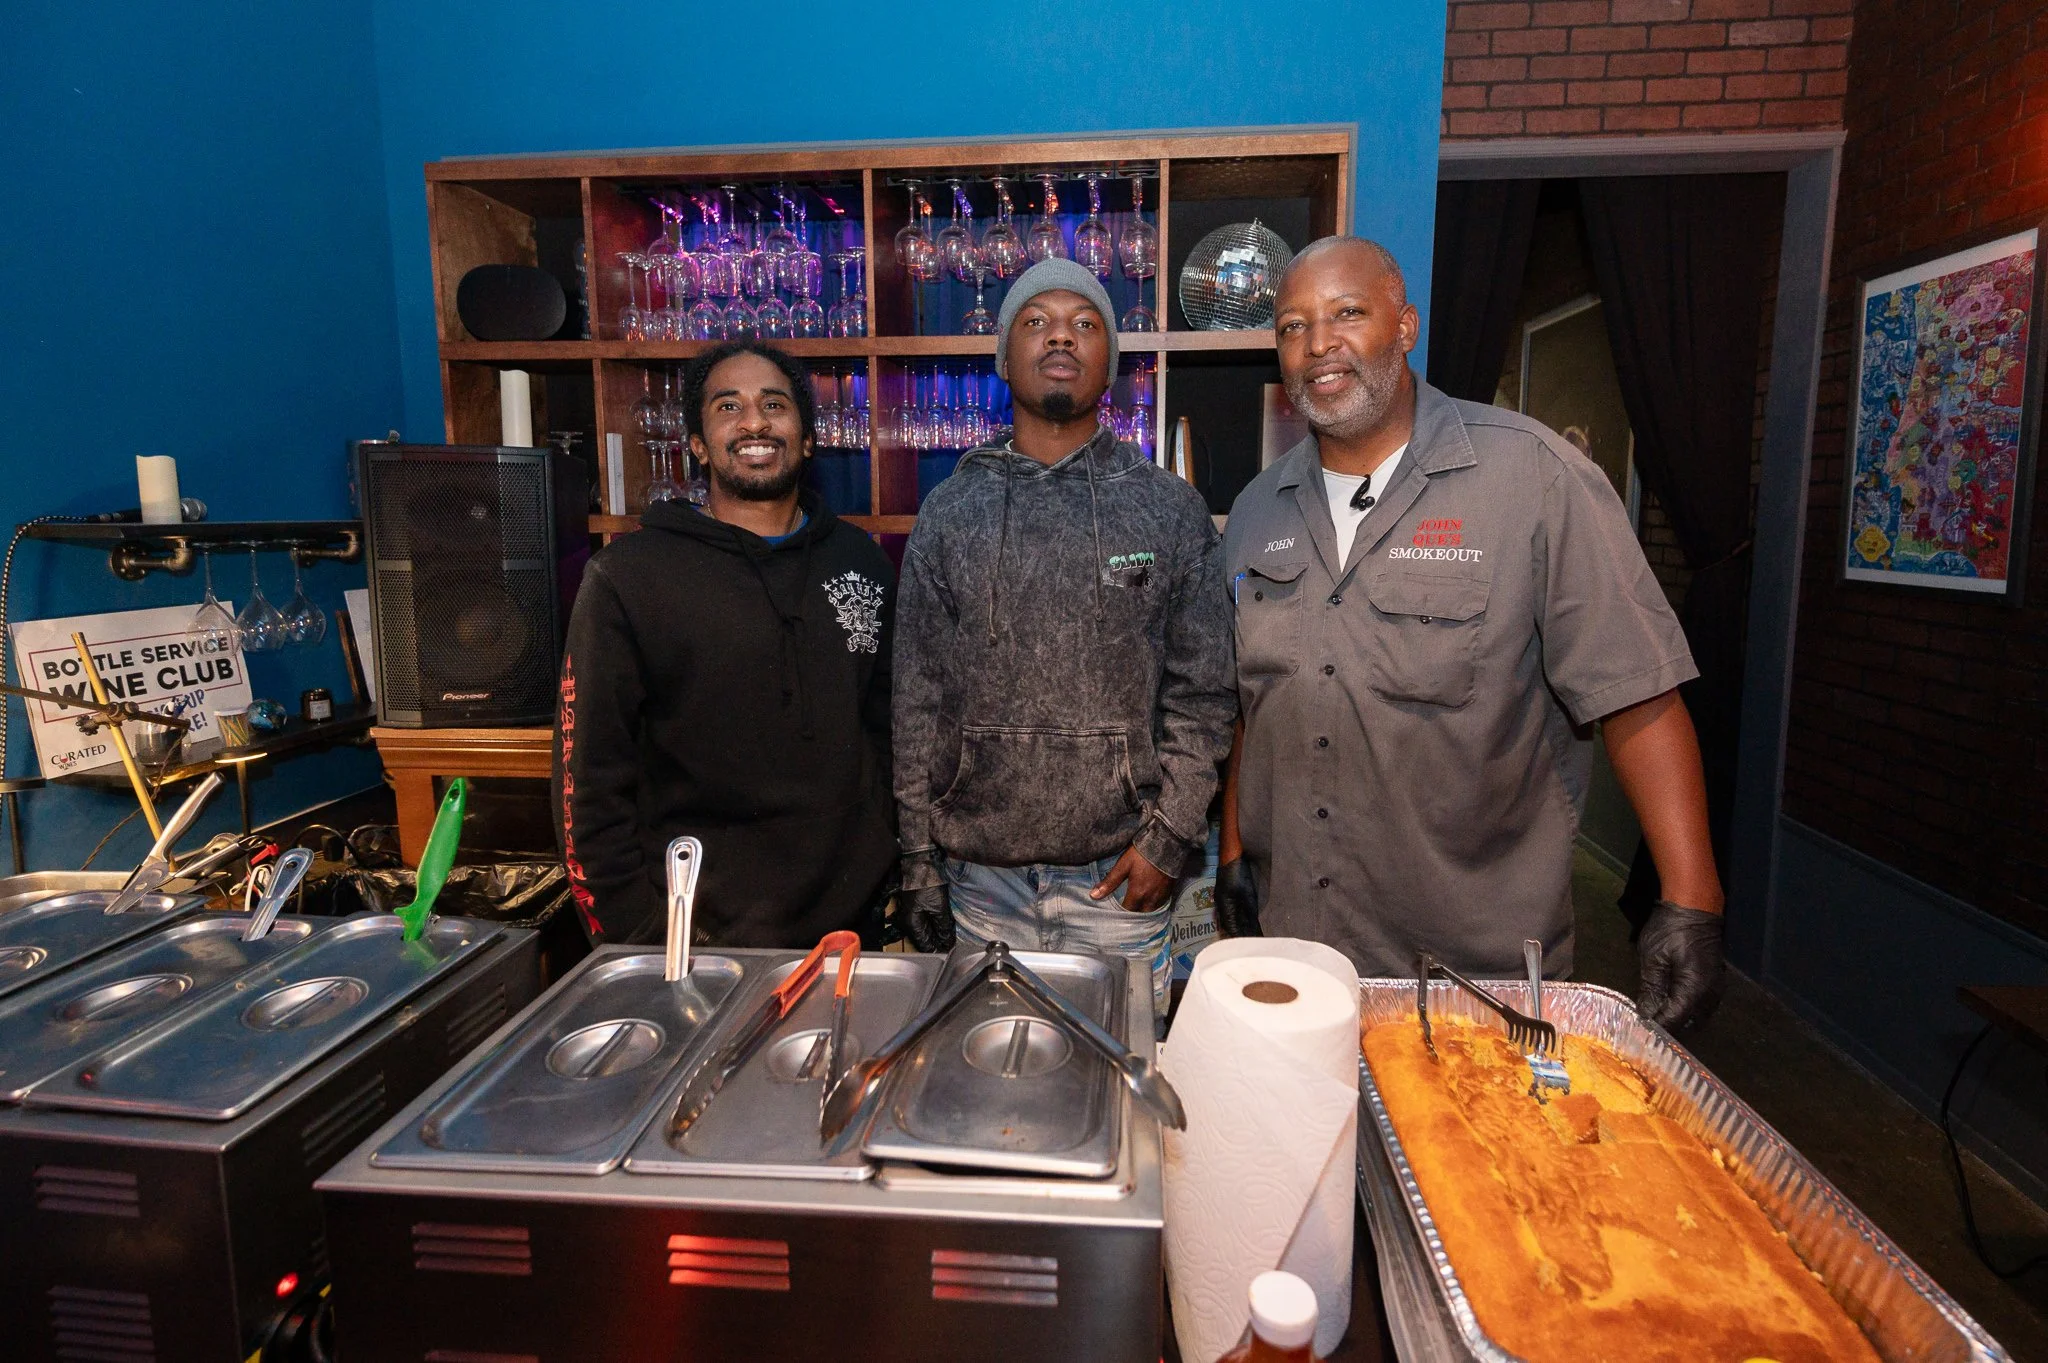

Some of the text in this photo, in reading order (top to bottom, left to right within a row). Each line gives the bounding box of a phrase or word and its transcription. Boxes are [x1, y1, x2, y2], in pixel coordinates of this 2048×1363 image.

[1415, 518, 1463, 531] JOHN
[1264, 537, 1295, 552] JOHN
[1388, 547, 1483, 562] SMOKEOUT
[42, 636, 229, 680] BOTLE SERVICE
[156, 658, 235, 691] CLUB
[442, 692, 490, 701] Pioneer
[51, 744, 107, 766] CURATED
